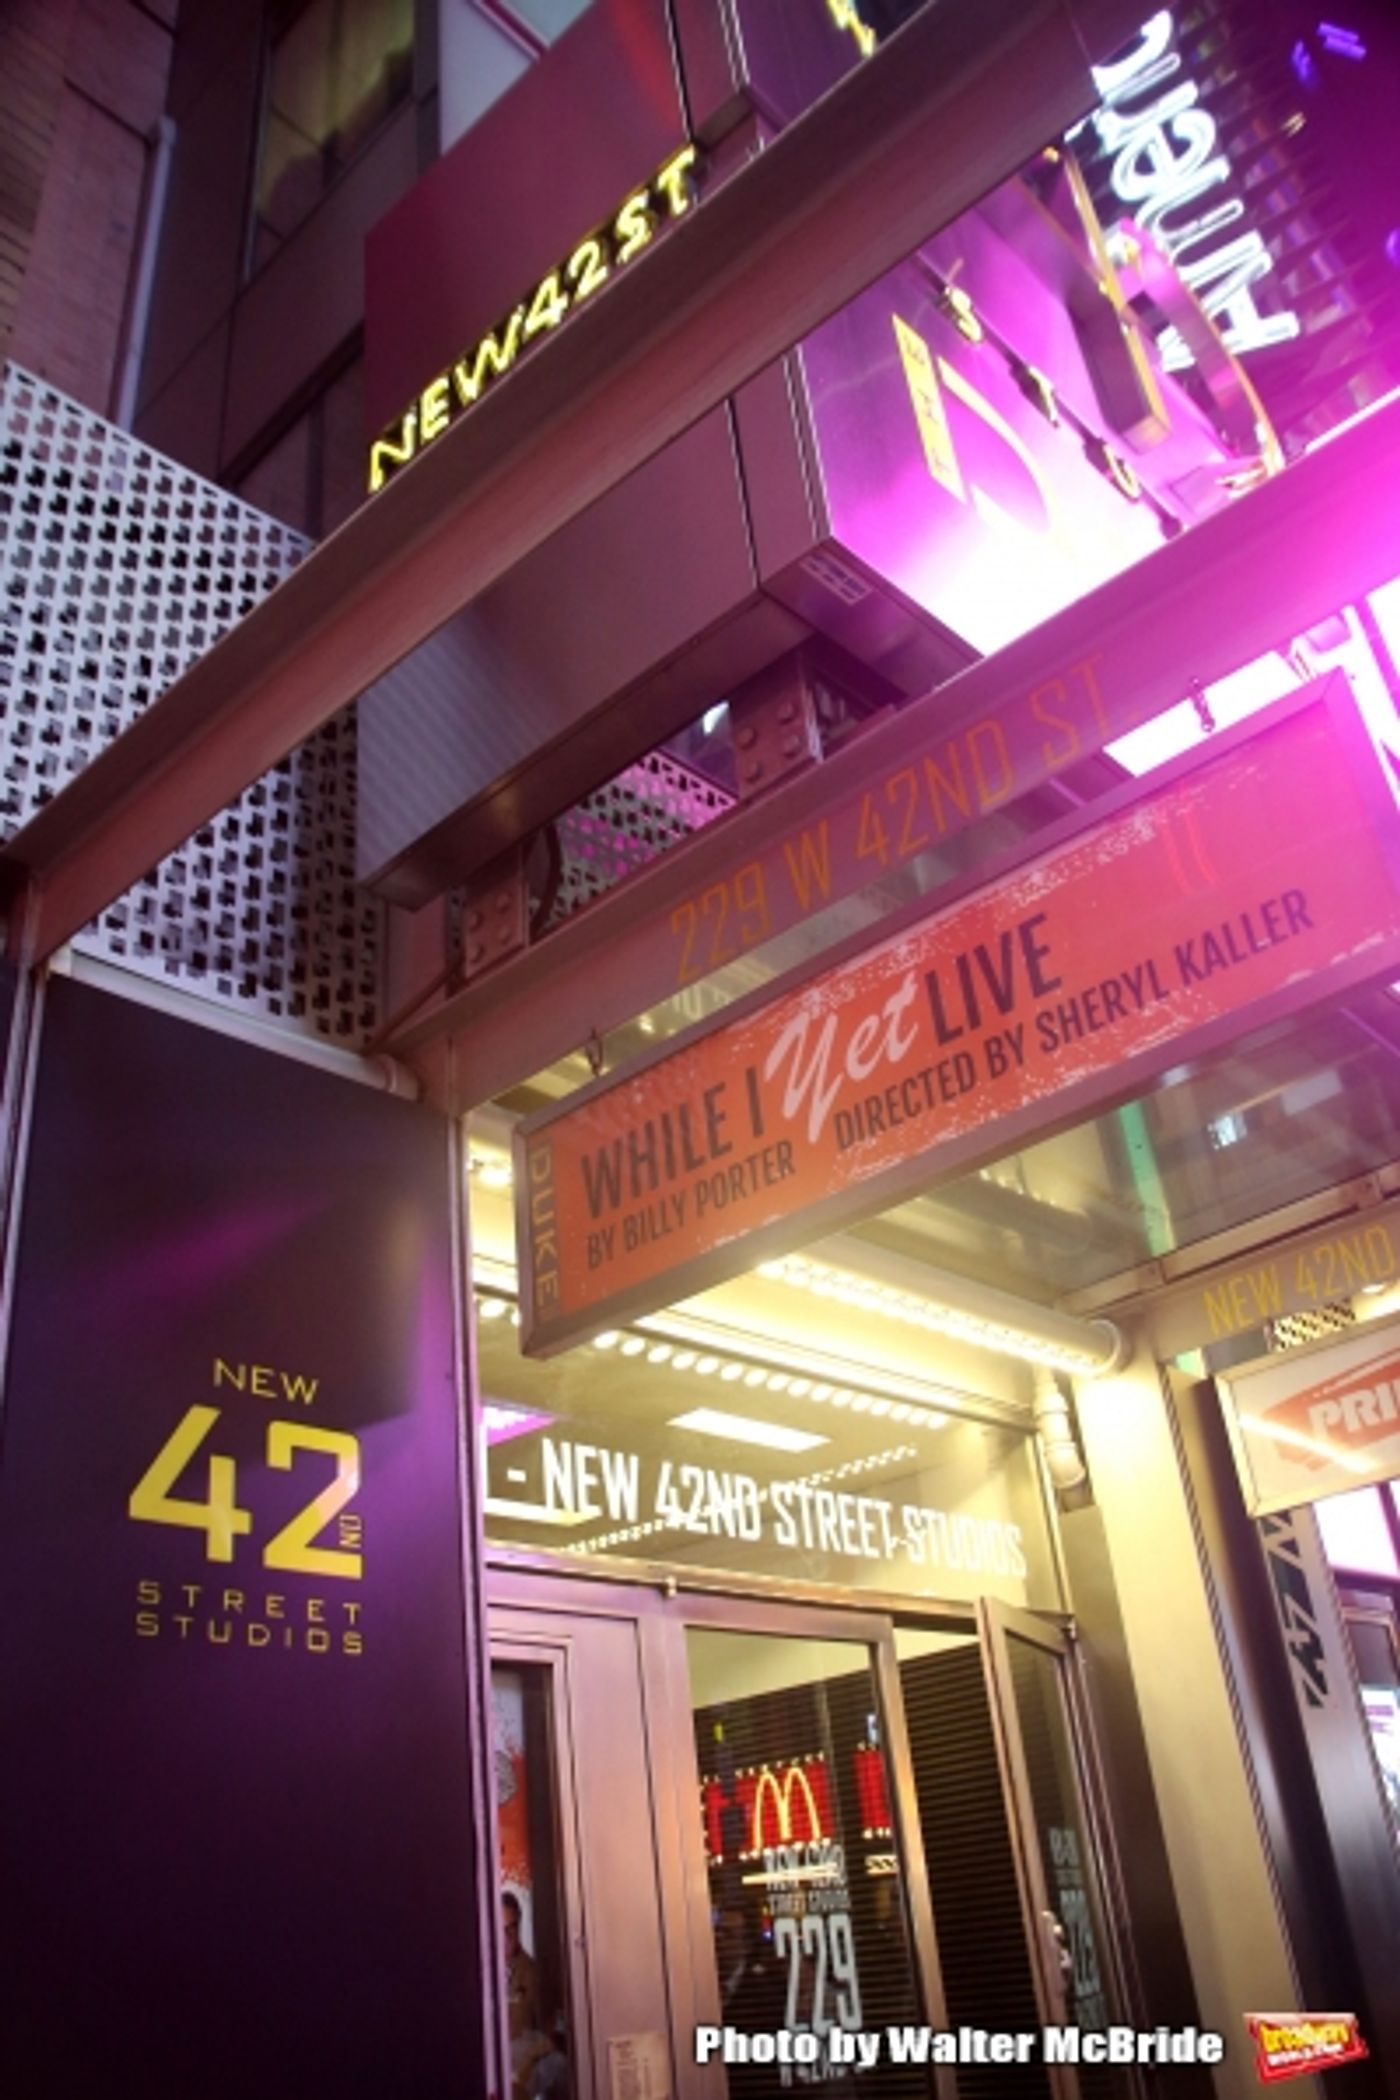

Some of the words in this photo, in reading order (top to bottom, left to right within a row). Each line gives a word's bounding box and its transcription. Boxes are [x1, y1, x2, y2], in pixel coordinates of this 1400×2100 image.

[671, 861, 773, 984] 229
[783, 816, 833, 914] W
[856, 716, 1016, 866] 42ND
[581, 1080, 733, 1220] WHILE
[744, 1067, 764, 1138] I
[764, 973, 919, 1145] Yet
[925, 914, 1062, 1046] LIVE
[586, 1229, 616, 1271] BY
[622, 1189, 687, 1253] BILLY
[695, 1139, 796, 1216] PORTER
[833, 1050, 976, 1151] DIRECTED
[983, 1028, 1026, 1081] BY
[1034, 955, 1171, 1054] SHERYL
[1174, 887, 1315, 989] KALLER
[531, 1146, 560, 1307] DUKE
[1203, 1264, 1284, 1337] NEW
[1296, 1224, 1396, 1300] 42ND
[213, 1358, 319, 1405] NEW
[1308, 1379, 1400, 1444] PRI
[129, 1404, 362, 1579] 42
[542, 1437, 639, 1523] NEW
[655, 1461, 761, 1541] 42ND
[770, 1479, 894, 1560] STREET
[901, 1505, 1027, 1579] STUDIOS
[136, 1613, 363, 1656] STUDIOS
[137, 1582, 361, 1625] STREET
[774, 1913, 863, 2036] 229
